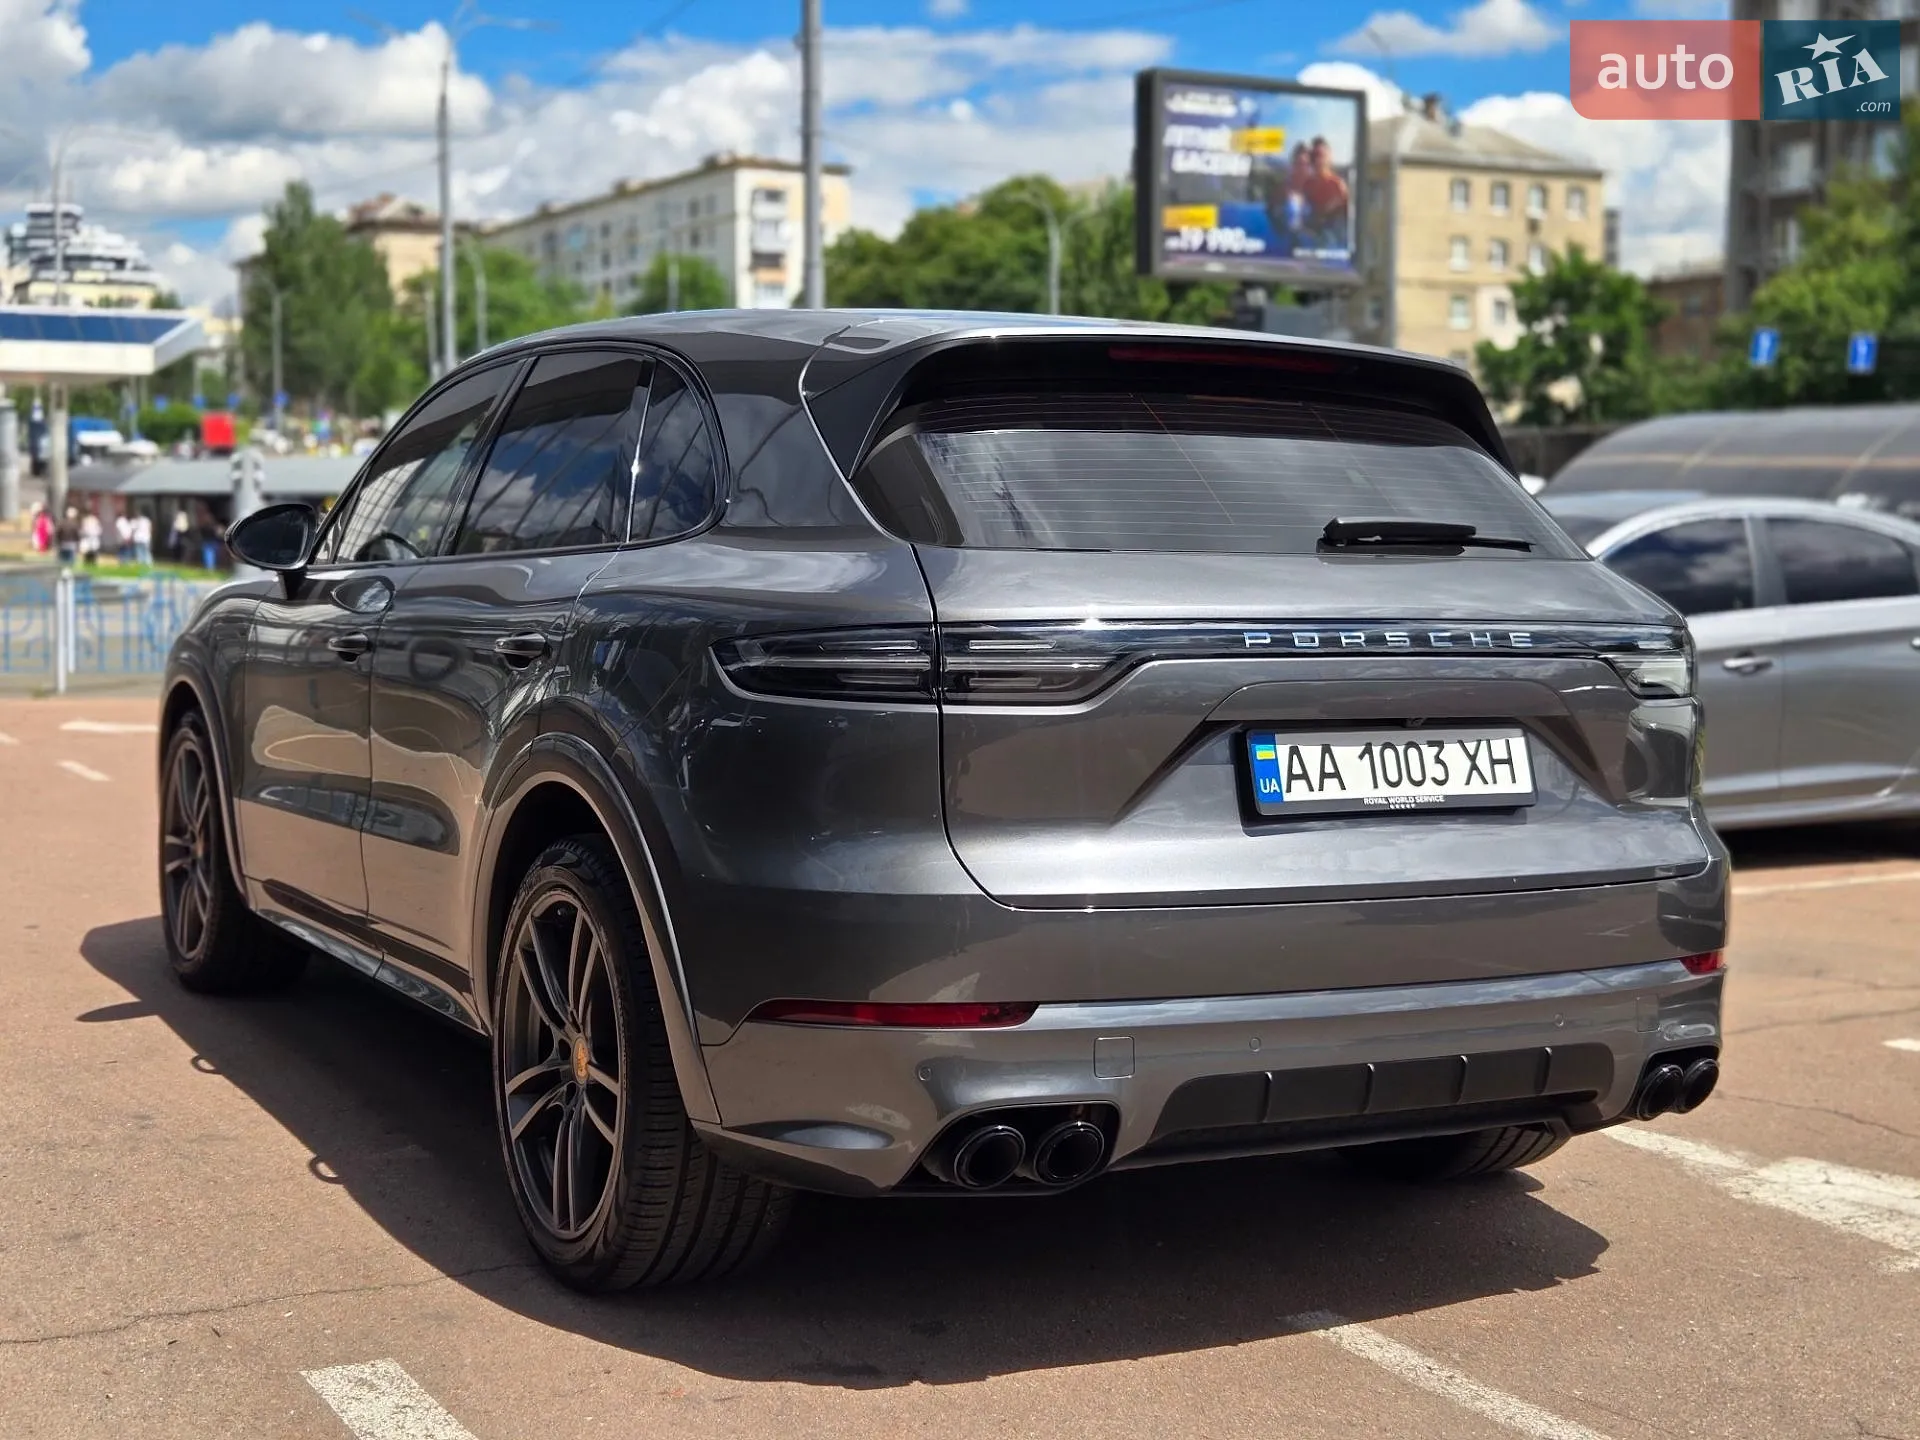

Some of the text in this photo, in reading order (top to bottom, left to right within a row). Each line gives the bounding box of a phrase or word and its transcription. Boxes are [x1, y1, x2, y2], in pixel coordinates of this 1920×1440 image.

[1243, 631, 1533, 649] PORSCHE
[1285, 739, 1517, 793] AA 1003 XH
[1260, 778, 1281, 794] UA
[1363, 794, 1445, 805] ROYAL WORLD SERVICE
